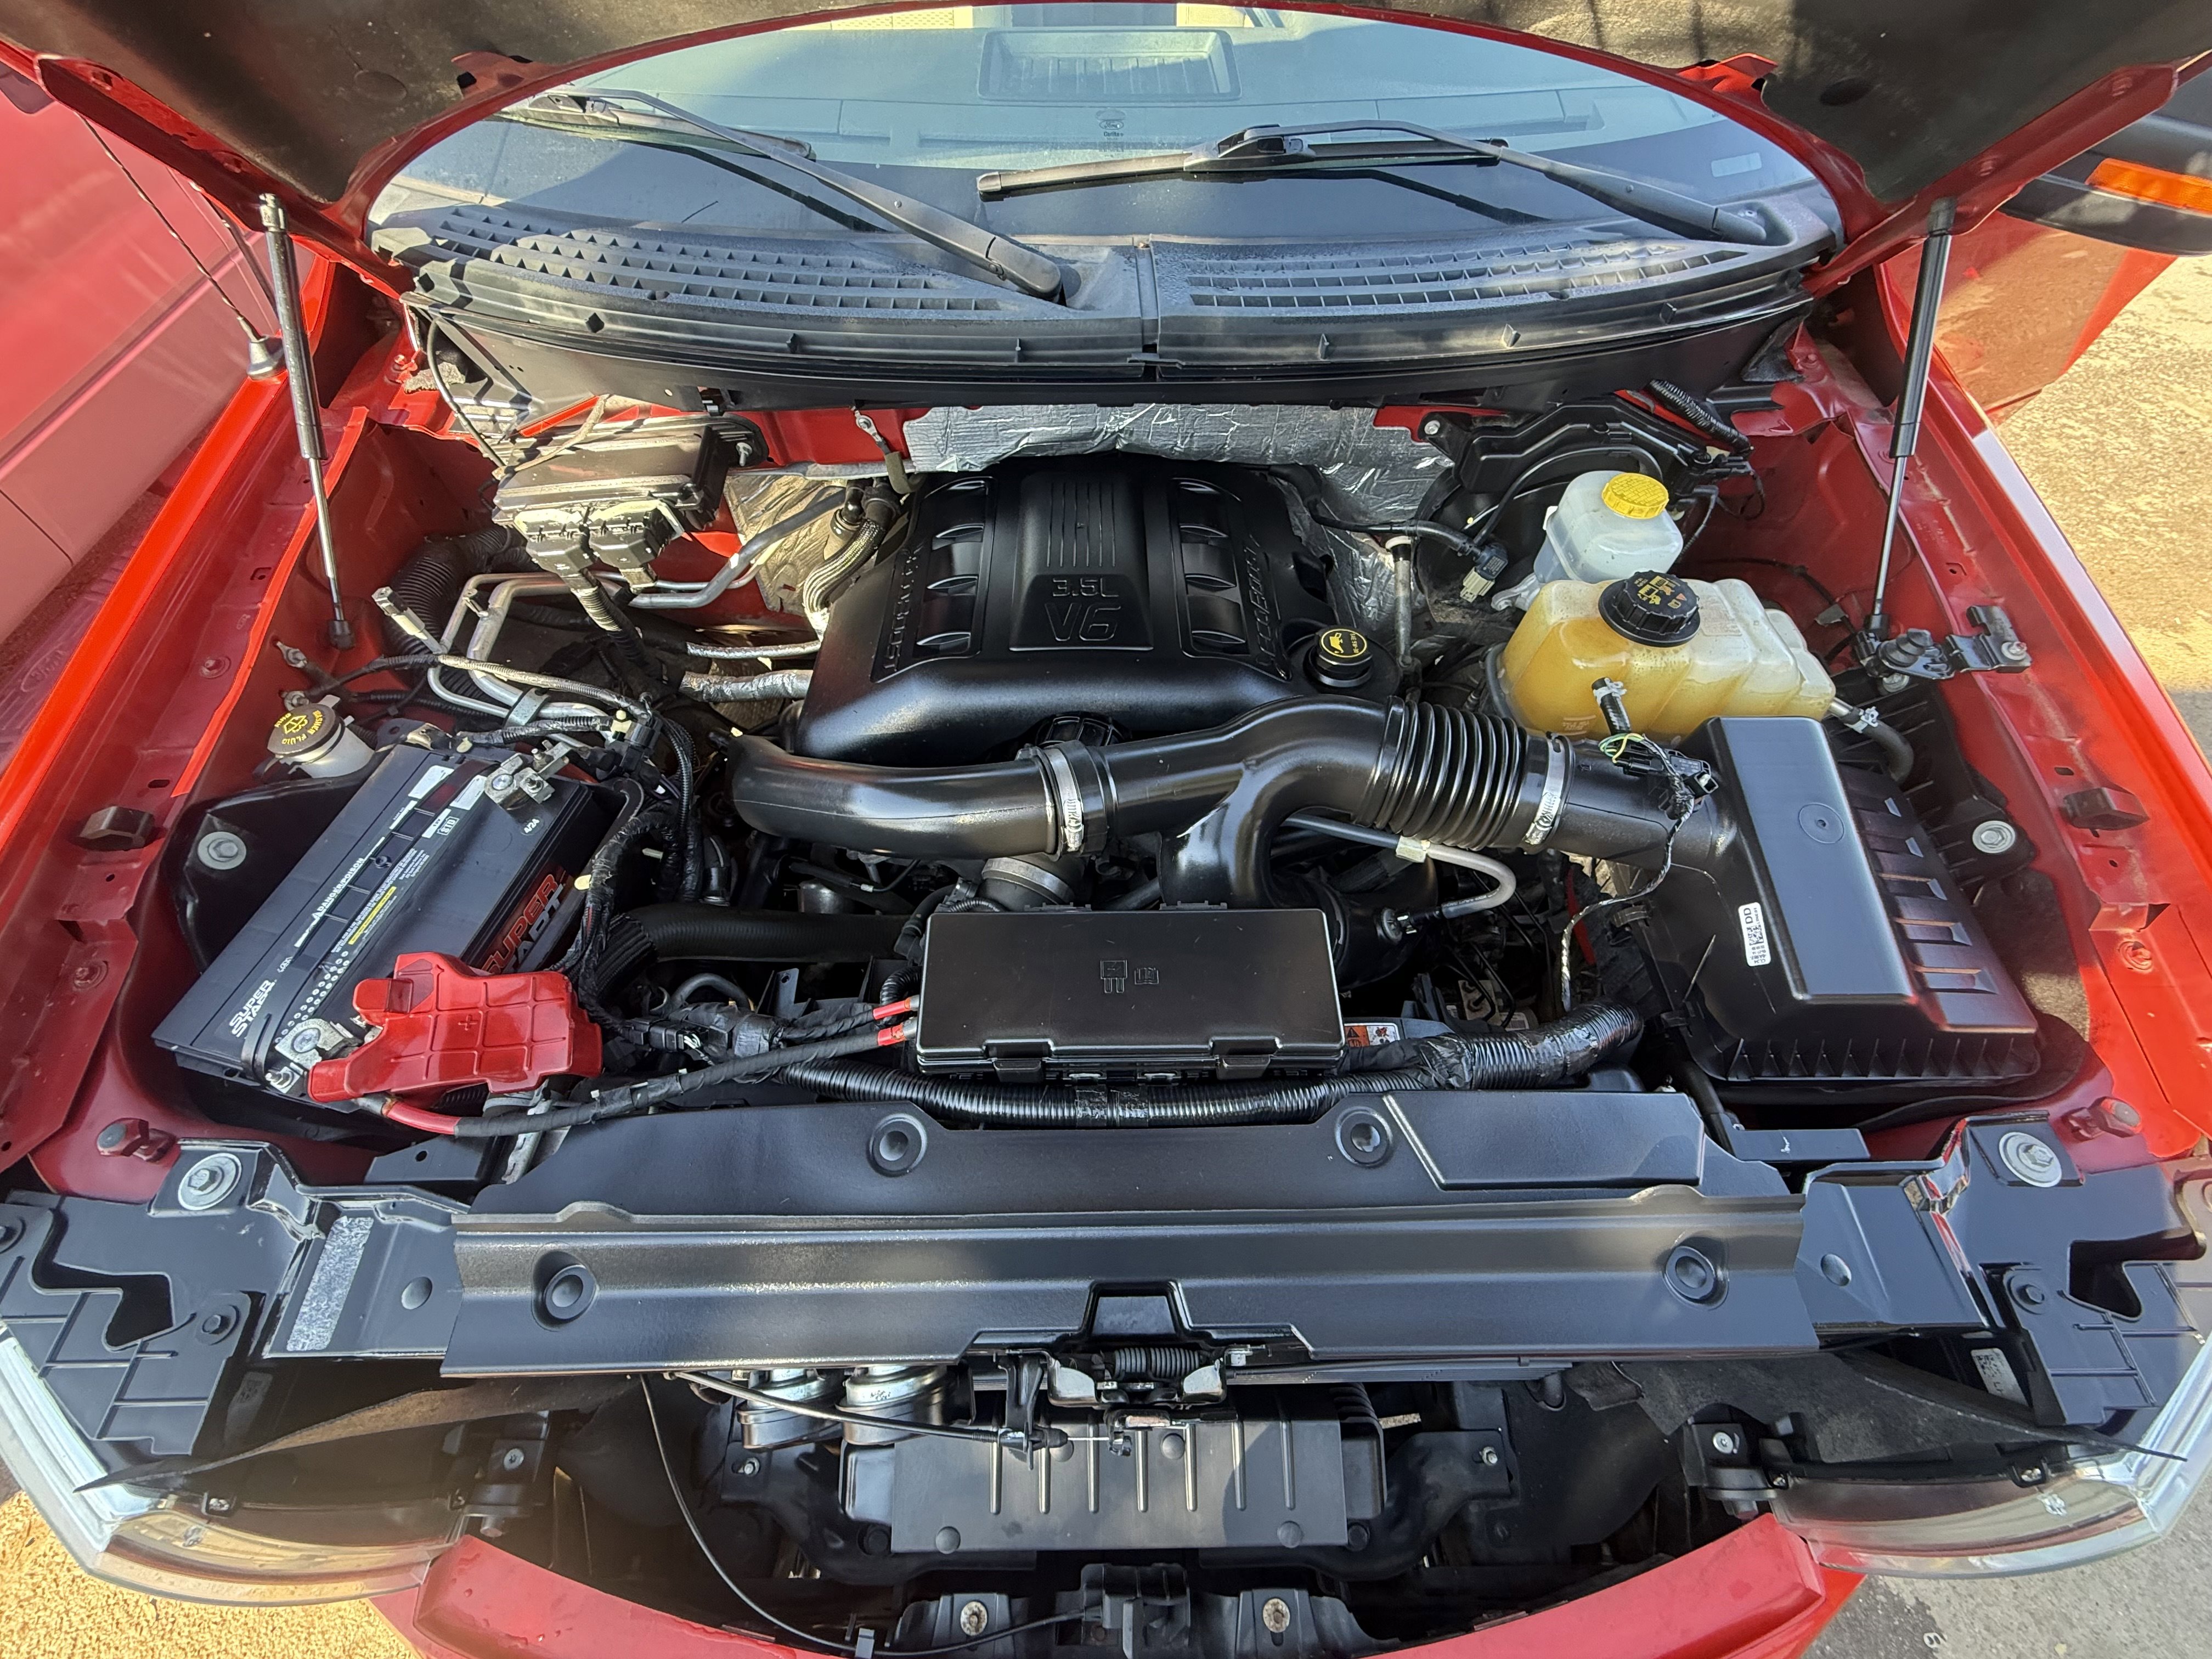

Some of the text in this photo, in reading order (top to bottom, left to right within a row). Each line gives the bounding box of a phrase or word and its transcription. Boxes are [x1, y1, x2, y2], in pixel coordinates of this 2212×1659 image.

[1053, 578, 1119, 597] 3.5L
[1044, 603, 1121, 641] V6
[281, 733, 307, 745] FLUID
[441, 819, 456, 833] STD
[524, 819, 540, 833] 4/24
[1743, 907, 1753, 924] DD
[229, 980, 272, 1026] SUPER
